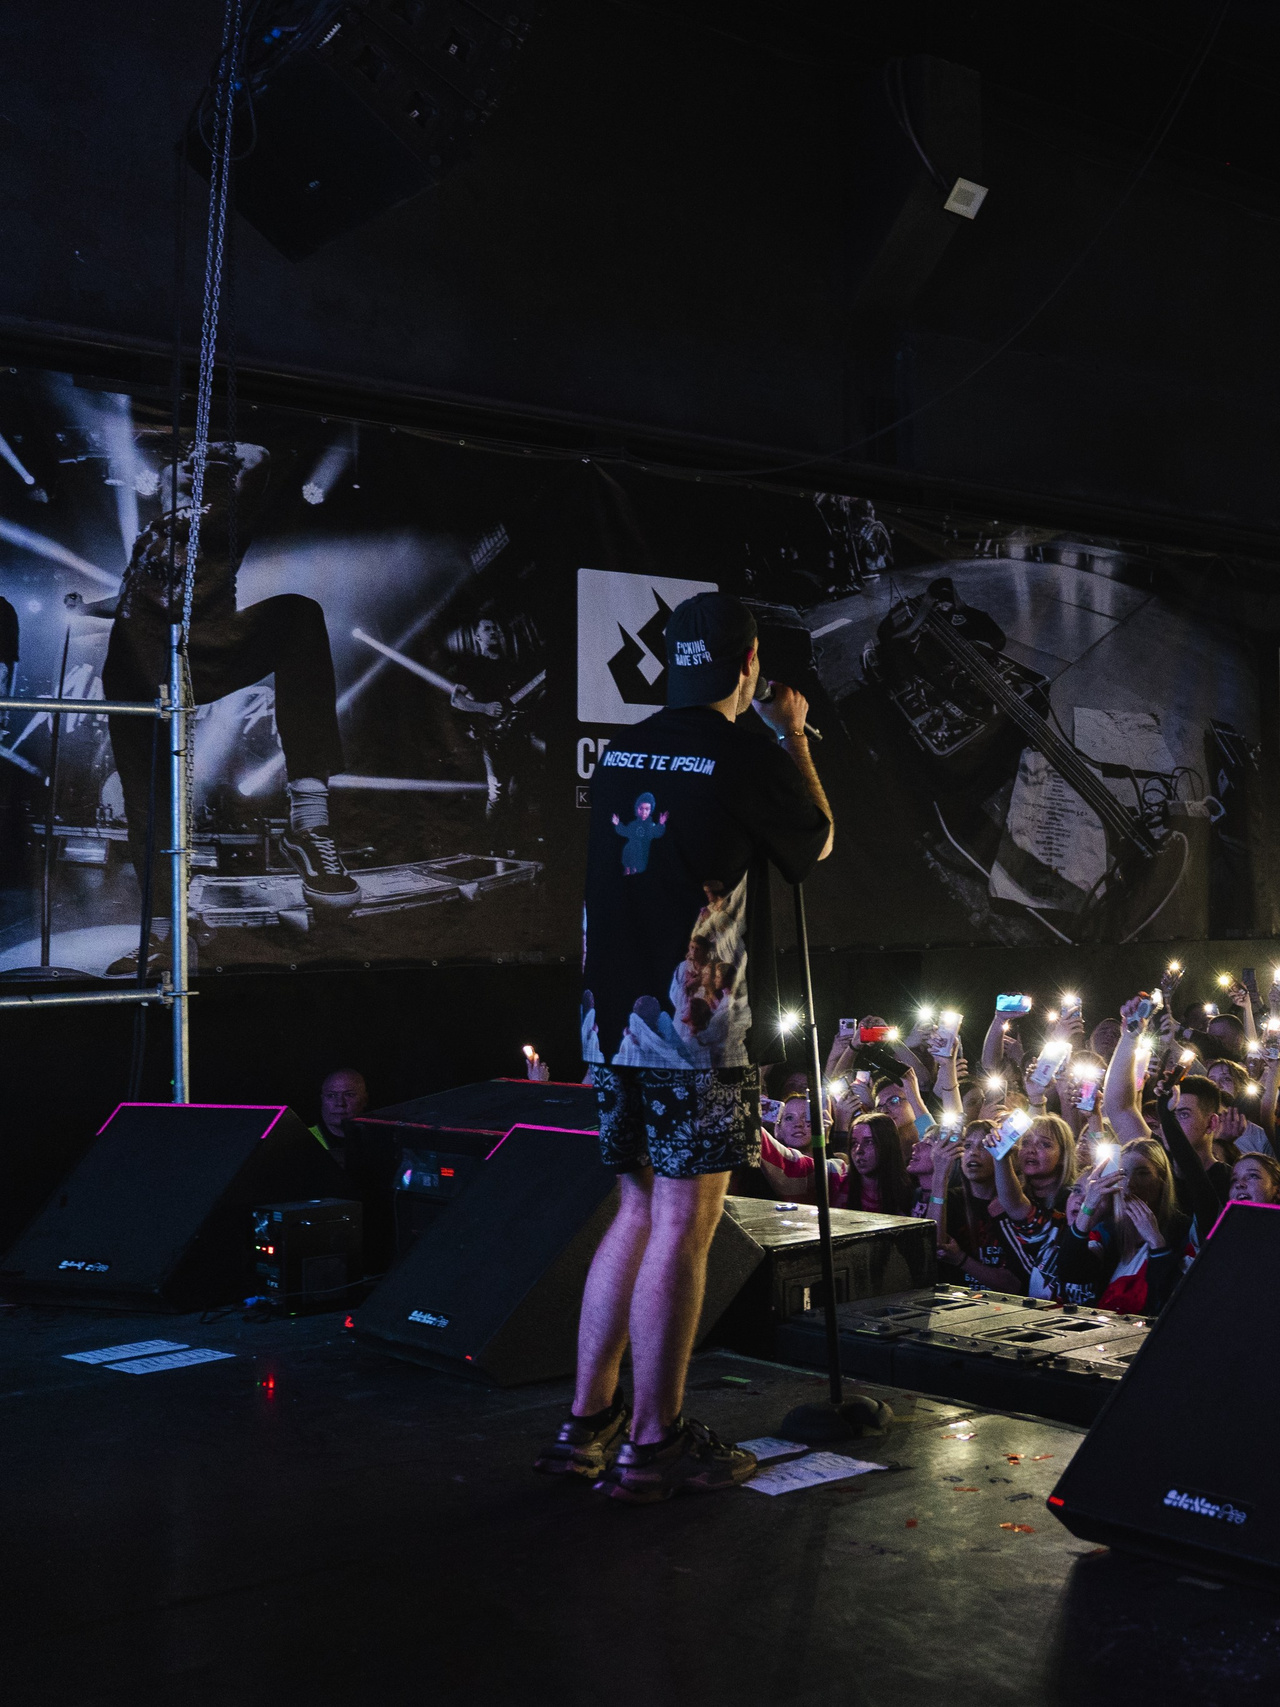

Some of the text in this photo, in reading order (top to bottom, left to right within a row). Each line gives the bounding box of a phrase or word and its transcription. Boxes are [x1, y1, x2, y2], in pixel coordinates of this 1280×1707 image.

[603, 751, 649, 769] NOSCE
[649, 755, 670, 771] TE
[670, 757, 717, 776] IPSUM
